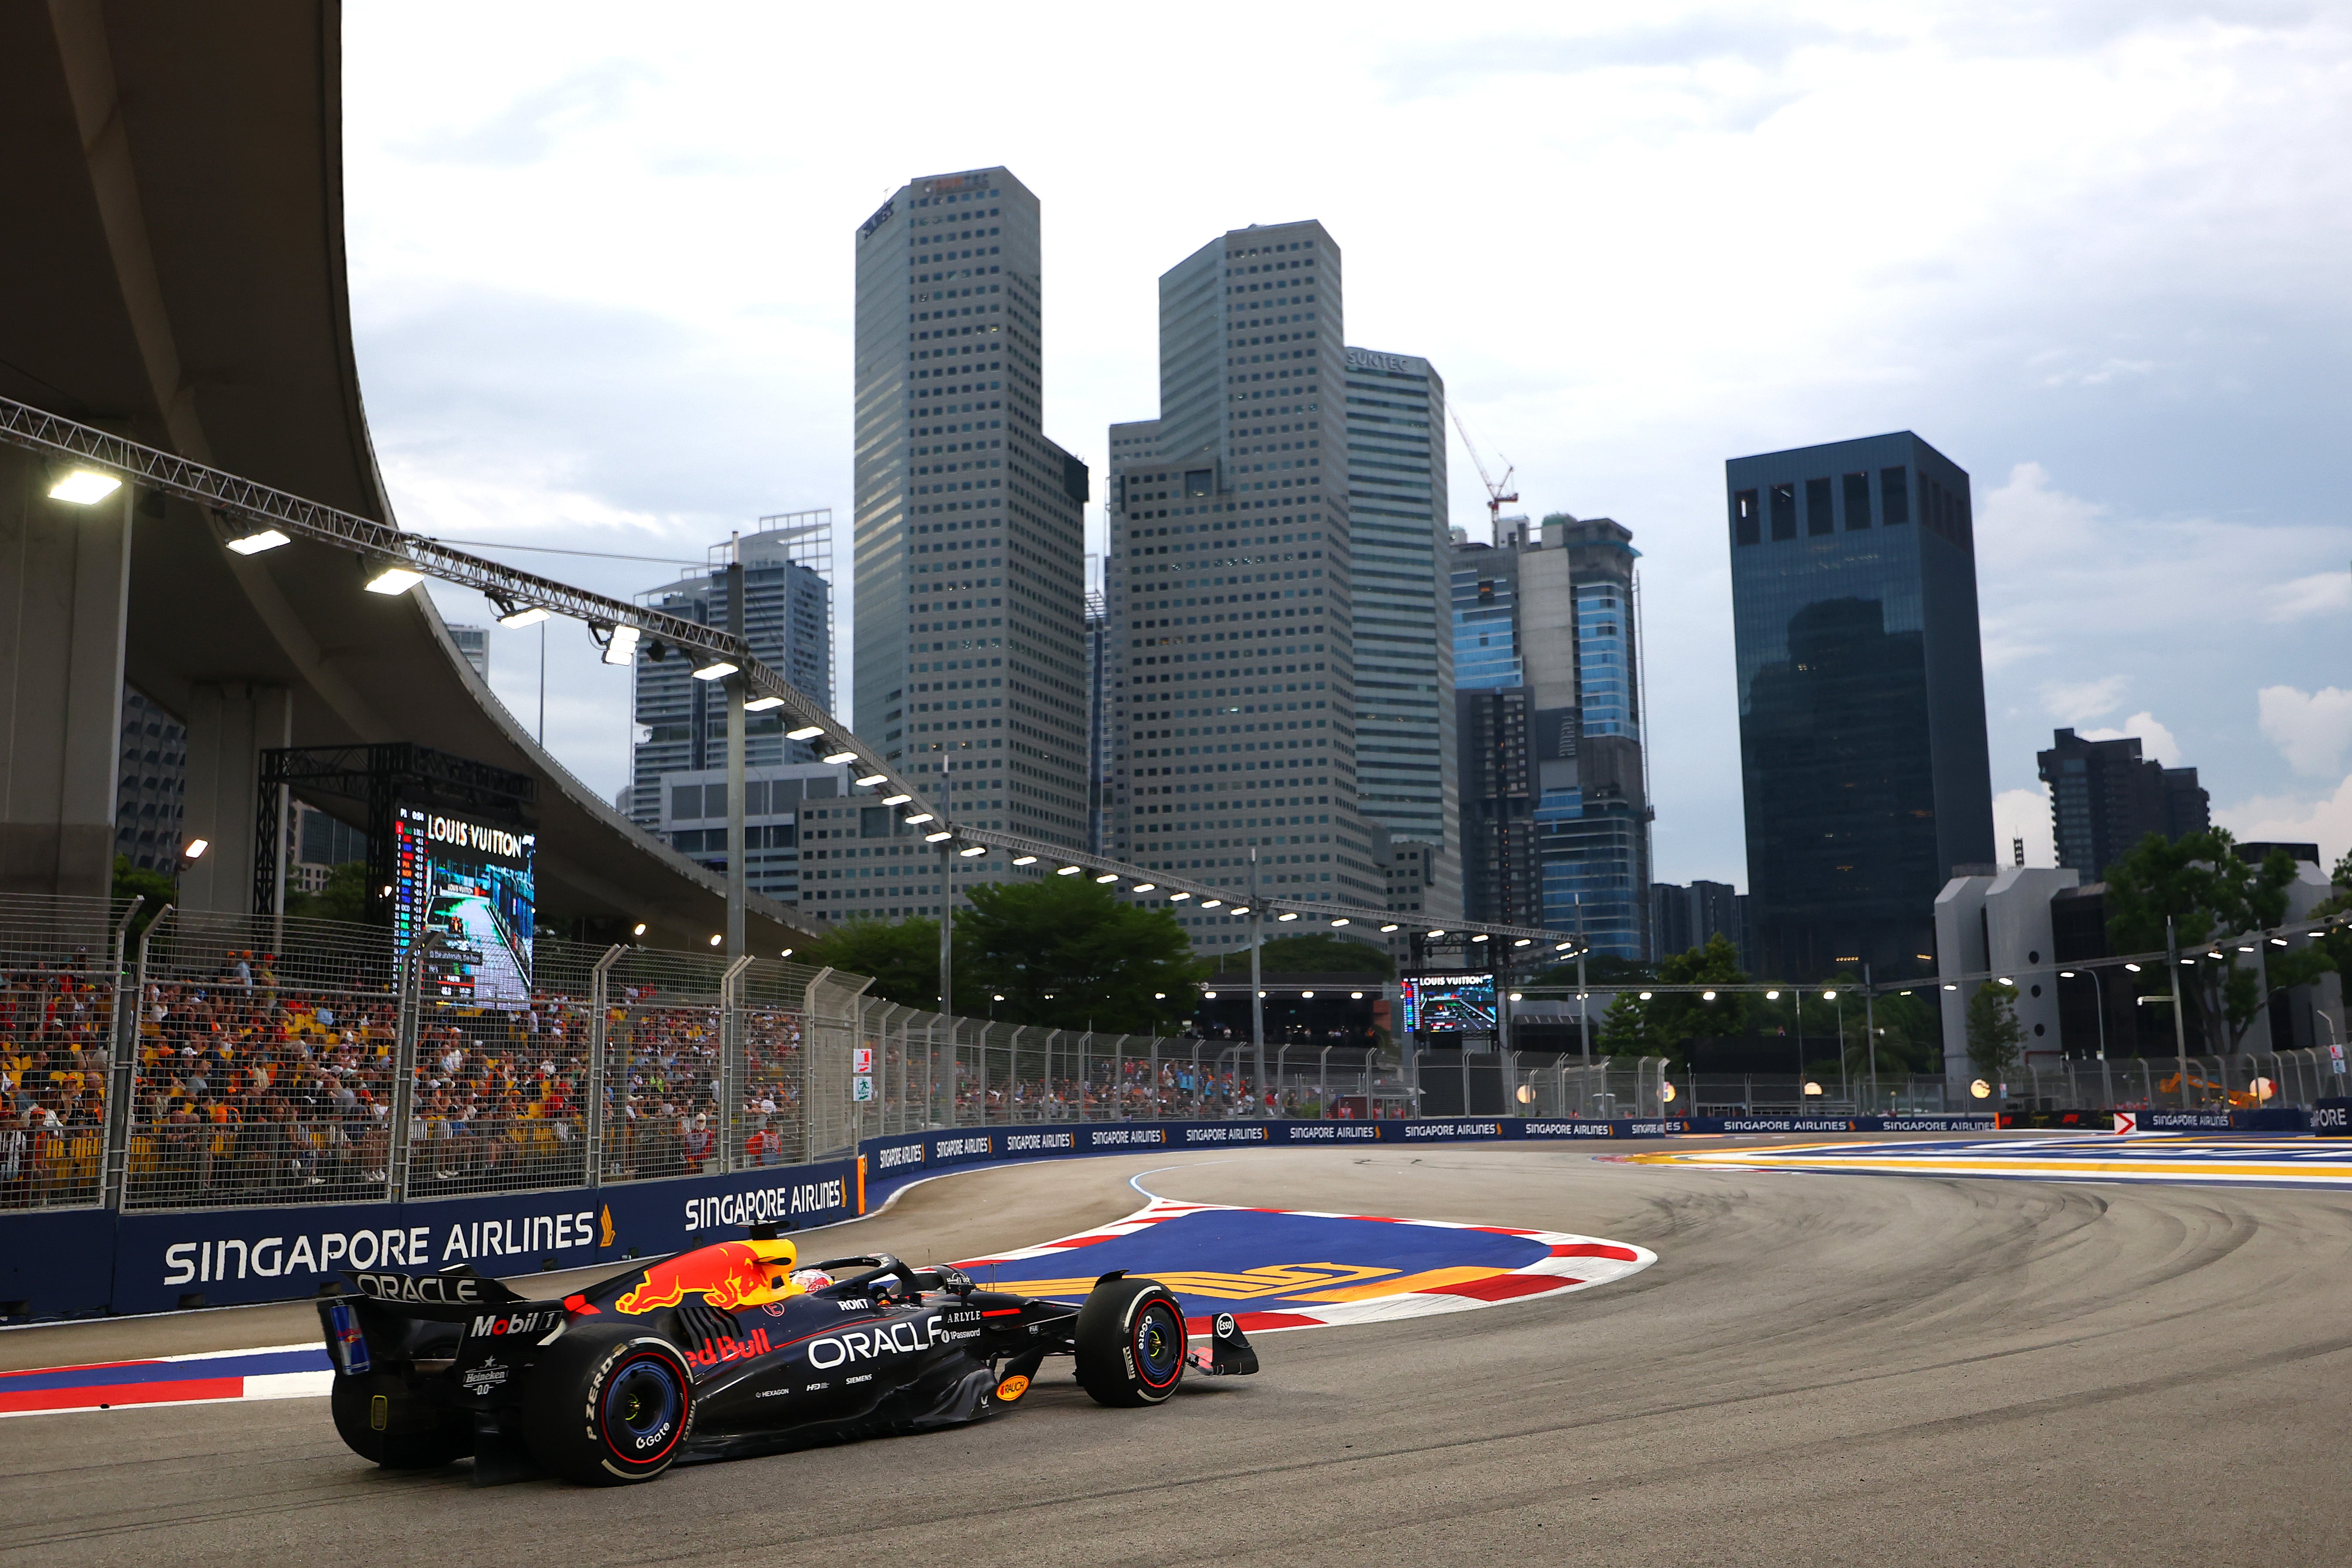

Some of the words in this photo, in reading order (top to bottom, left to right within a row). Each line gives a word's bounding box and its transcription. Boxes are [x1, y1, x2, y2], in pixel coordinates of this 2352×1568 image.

[1347, 351, 1407, 372] SUNTEC
[428, 813, 468, 847] LOUIS
[470, 824, 521, 859] VUITTON
[1419, 977, 1445, 986] LOUIS
[1446, 976, 1483, 985] VUITTON
[1724, 1120, 1790, 1131] SINGAPORE
[1794, 1121, 1847, 1131] AIRLINES
[1883, 1121, 1947, 1131] SINGAPORE
[1951, 1121, 1996, 1132] AIRLINES
[2153, 1114, 2198, 1126] SINGAPORE
[2199, 1115, 2229, 1126] AIRLINES
[1186, 1129, 1227, 1141] SINGAPORE
[1228, 1127, 1262, 1140] AIRLINES
[1290, 1127, 1335, 1139] SINGAPORE
[1336, 1126, 1374, 1138] AIRLINES
[1405, 1125, 1455, 1137] SINGAPORE
[1457, 1124, 1496, 1135] AIRLINES
[1526, 1123, 1571, 1134] SINGAPORE
[1574, 1124, 1608, 1136] AIRLINES
[1007, 1135, 1040, 1151] SINGAPORE
[1042, 1133, 1070, 1148] AIRLINES
[1092, 1131, 1129, 1145] SINGAPORE
[1131, 1130, 1161, 1143] AIRLINES
[936, 1139, 963, 1158] SINGAPORE
[964, 1137, 988, 1154] AIRLINES
[880, 1147, 902, 1169] SINGAPORE
[902, 1144, 922, 1164] AIRLINES
[685, 1187, 786, 1232] SINGAPORE
[790, 1179, 840, 1215] AIRLINES
[164, 1226, 430, 1286] SINGAPORE
[442, 1211, 594, 1261] AIRLINES
[357, 1274, 477, 1303] ORACLE
[836, 1298, 869, 1311] ROKT
[947, 1310, 980, 1323] ARLYLE
[470, 1312, 539, 1337] Mobil
[544, 1313, 555, 1329] 1
[1219, 1319, 1231, 1331] Esso
[950, 1327, 980, 1340] 1Password
[716, 1328, 772, 1361] Bull
[808, 1316, 943, 1370] ORACLE
[466, 1371, 505, 1383] Heineken
[846, 1374, 872, 1384] SIEMENS
[586, 1357, 614, 1421] ZERO
[762, 1388, 789, 1397] HEXAGON
[1004, 1381, 1025, 1394] RAUCH
[646, 1422, 671, 1446] Gate
